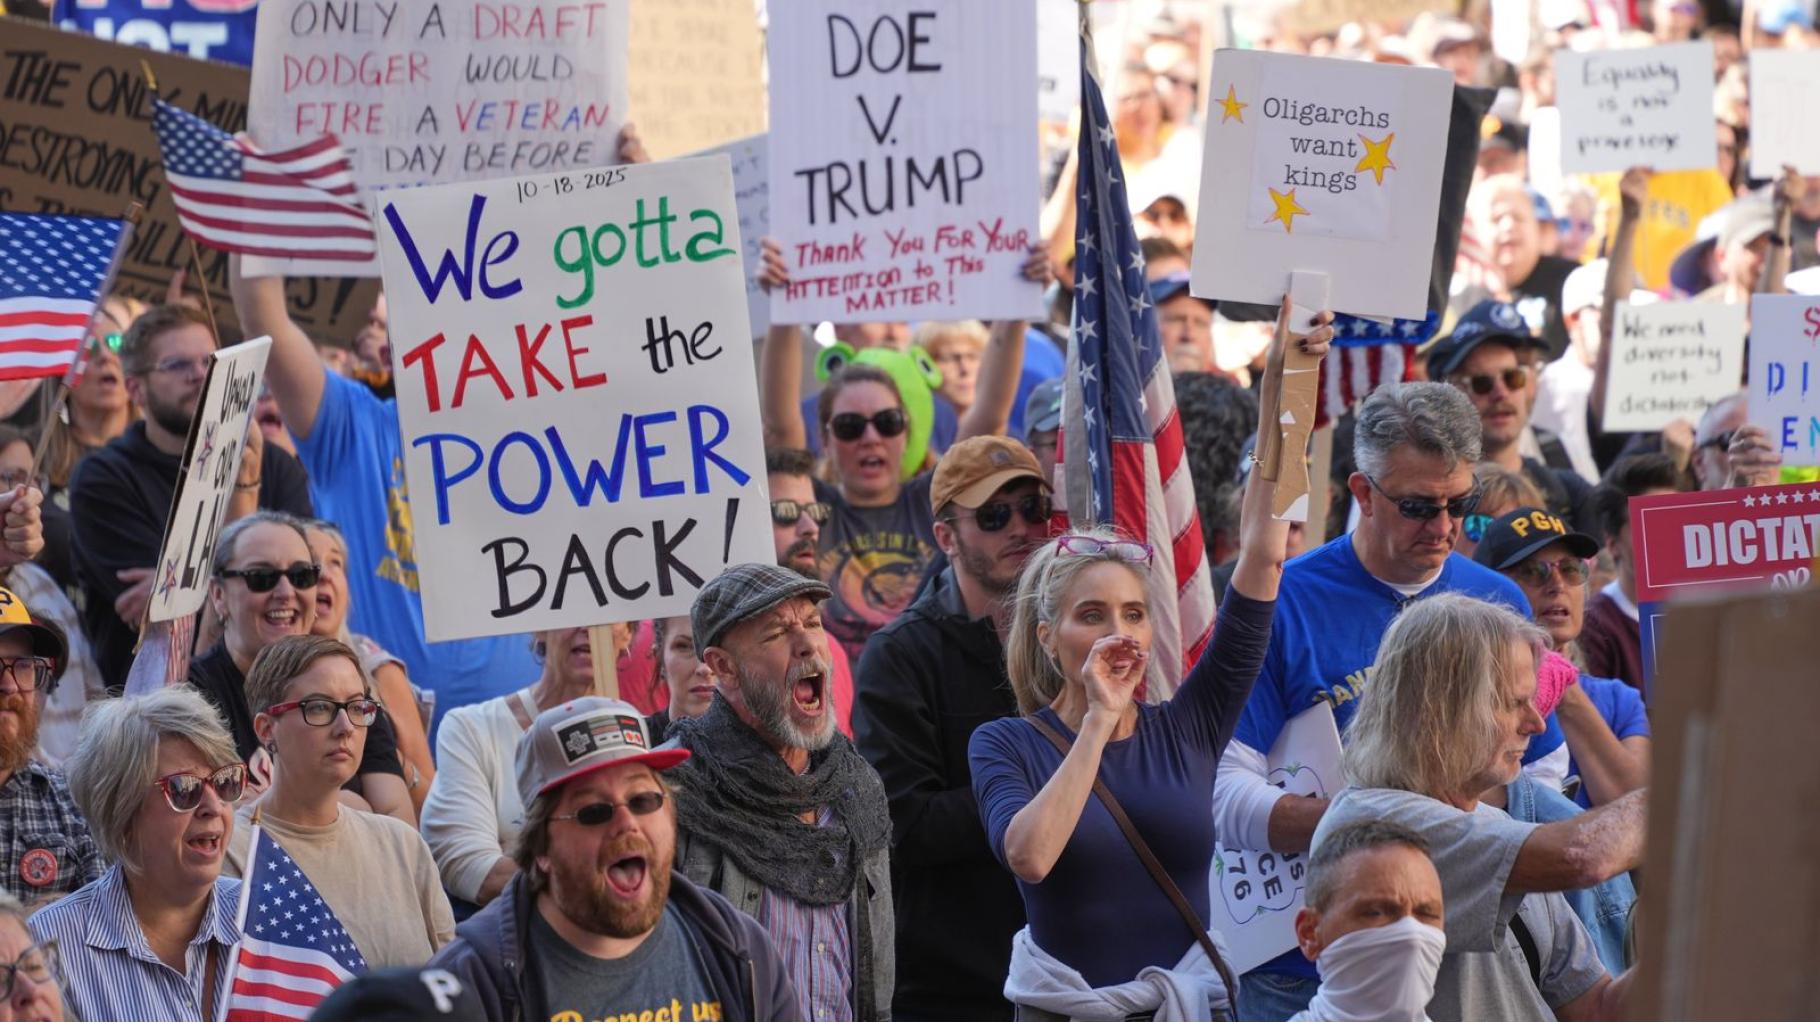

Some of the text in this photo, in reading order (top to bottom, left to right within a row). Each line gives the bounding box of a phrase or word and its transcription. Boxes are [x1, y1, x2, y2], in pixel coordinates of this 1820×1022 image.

[290, 2, 393, 37] ONLY
[420, 3, 446, 39] A
[474, 2, 604, 40] DRAFT
[827, 11, 942, 79] DOE
[4, 50, 81, 108] THE
[87, 66, 181, 122] ONL
[284, 51, 574, 93] DODGER WOULD
[296, 102, 385, 136] FIRE
[415, 105, 440, 135] A
[455, 102, 612, 134] VETERAN
[856, 94, 902, 146] V.
[1263, 97, 1390, 128] Oligarchs
[384, 143, 447, 176] DAY
[462, 139, 594, 173] BEFORE
[1290, 136, 1357, 158] want
[794, 148, 984, 226] TRUMP
[1283, 164, 1357, 194] kings
[382, 193, 524, 306] We
[553, 195, 738, 310] gotta
[401, 314, 724, 414] TAKE the
[412, 404, 752, 526] POWER
[178, 494, 225, 592] LA
[1511, 511, 1566, 537] PGH
[480, 497, 741, 619] BACK!
[420, 968, 464, 1013] P
